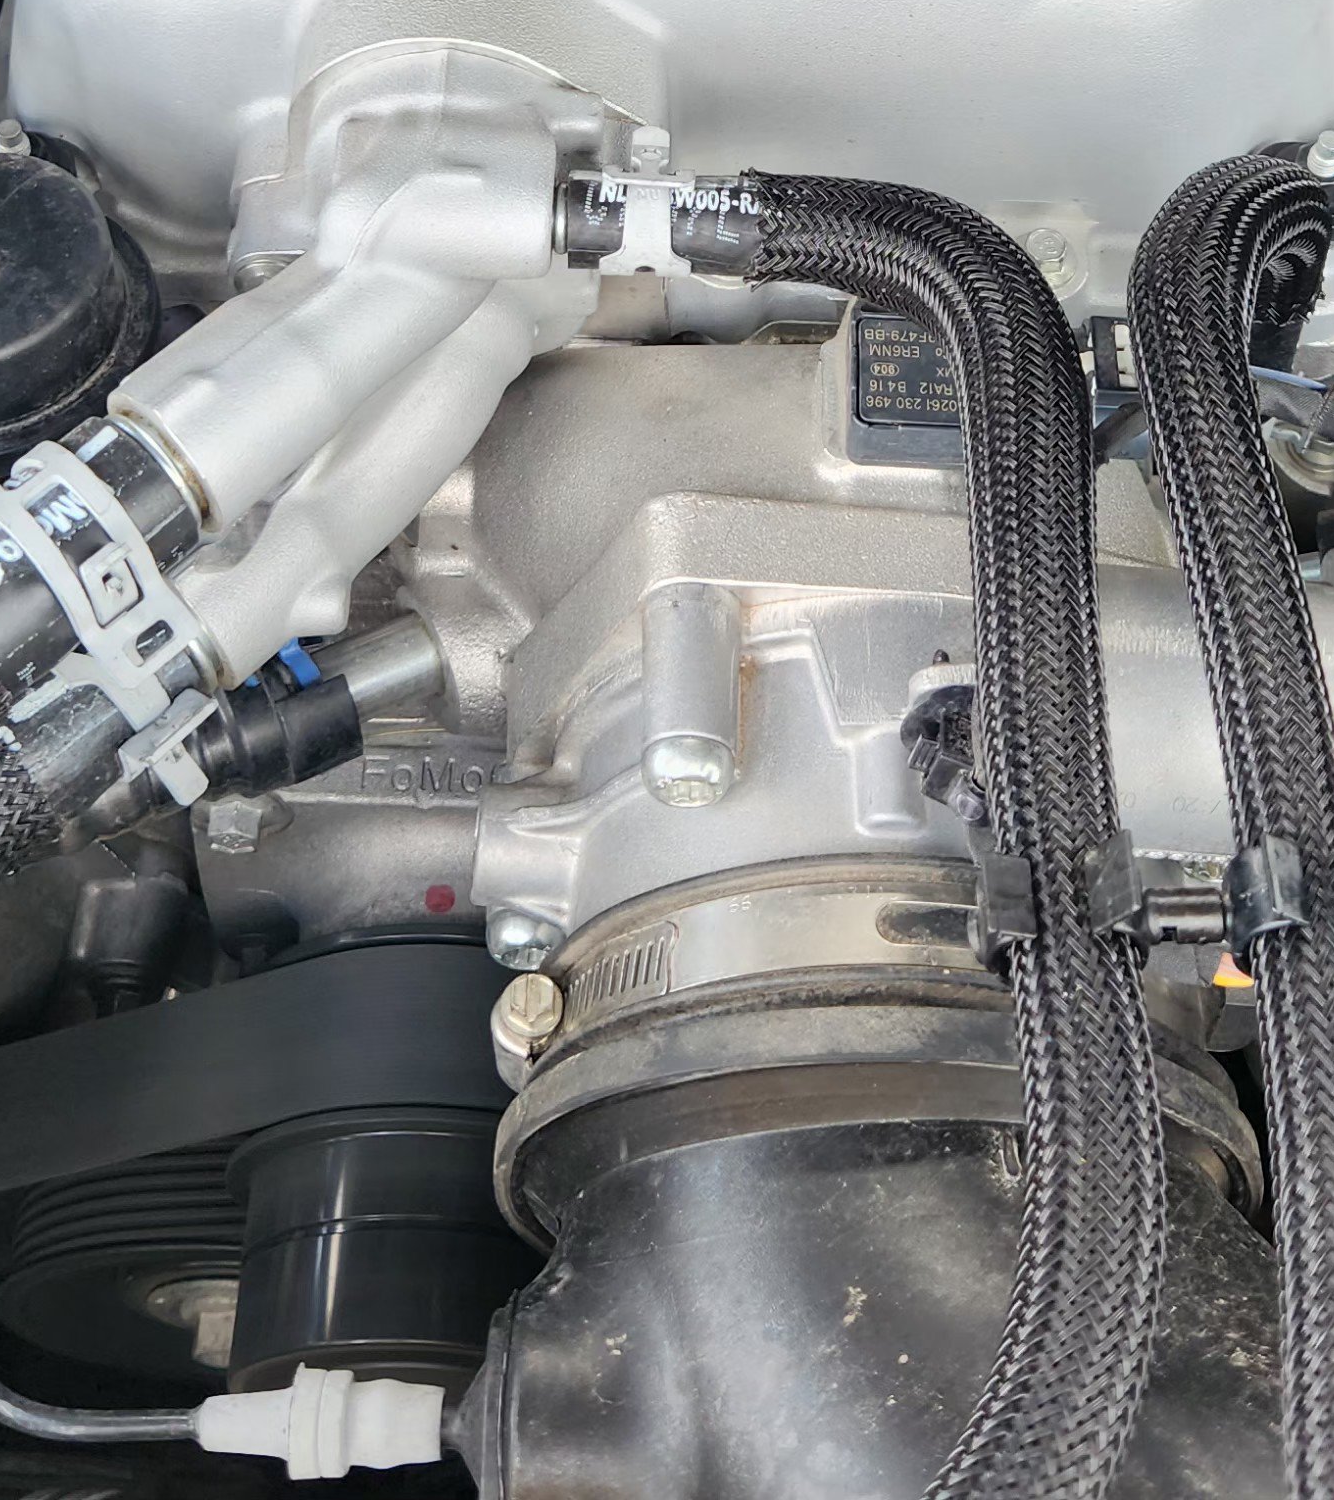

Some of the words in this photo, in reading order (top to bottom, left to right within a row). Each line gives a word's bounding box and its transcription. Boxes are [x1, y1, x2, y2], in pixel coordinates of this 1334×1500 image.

[869, 343, 920, 358] ER6NM
[919, 381, 953, 396] RA12
[865, 395, 892, 409] 496
[895, 396, 922, 410] 230
[926, 398, 958, 412] 0261
[361, 755, 509, 793] FoMoC
